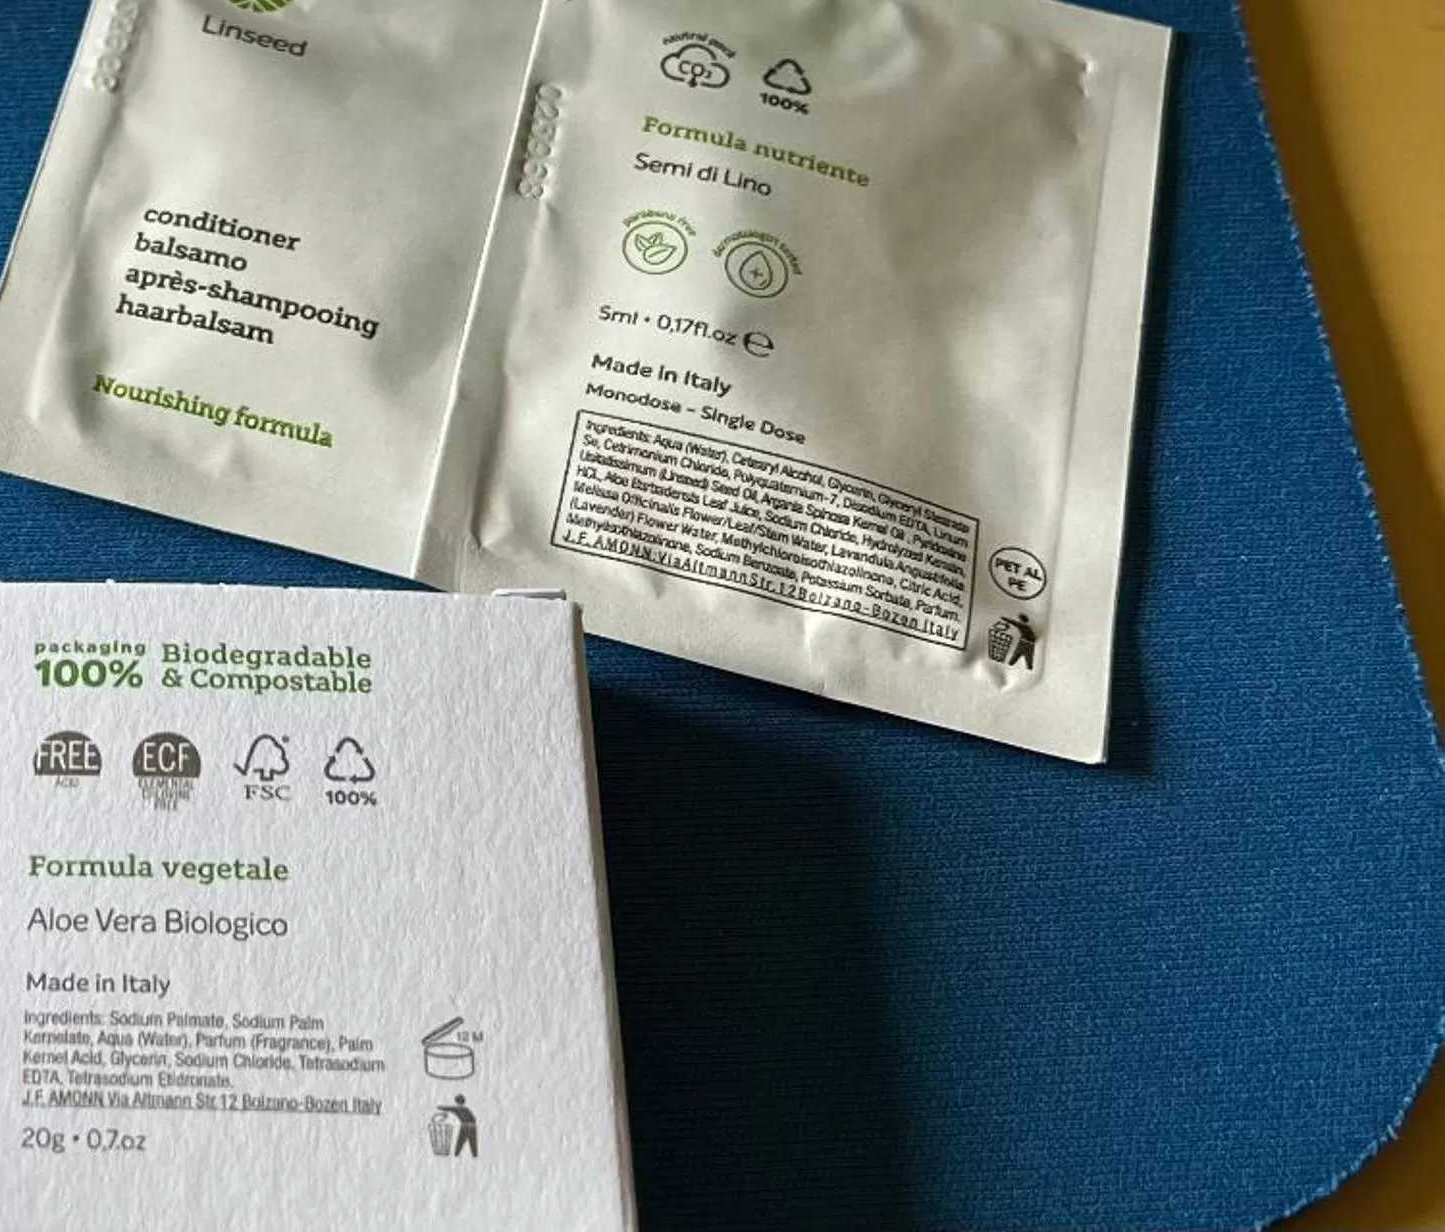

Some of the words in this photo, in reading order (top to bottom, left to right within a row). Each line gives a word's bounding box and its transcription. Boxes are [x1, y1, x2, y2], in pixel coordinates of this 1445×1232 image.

[202, 14, 308, 57] Linseed
[759, 92, 809, 115] 100%
[642, 116, 748, 152] Formula
[755, 141, 871, 188] nutriente
[633, 152, 693, 179] Semi
[697, 166, 718, 183] di
[724, 170, 772, 197] Lino
[144, 207, 301, 253] conditioner
[135, 233, 248, 273] balsamo
[125, 265, 380, 340] après-shampooing
[599, 305, 638, 326] 5ml
[116, 295, 275, 345] haarbalsam
[591, 354, 653, 377] Made
[658, 365, 678, 384] in
[684, 370, 732, 398] Italy
[93, 374, 231, 428] Nourishing
[233, 406, 335, 448] formula
[585, 382, 682, 414] Monodose
[700, 405, 756, 431] Single
[760, 420, 806, 445] Dose
[995, 557, 1022, 574] PET
[1008, 577, 1028, 592] PE
[34, 640, 146, 657] packaging
[162, 642, 372, 670] Biodegradable
[34, 659, 143, 689] 100%
[161, 670, 184, 688] &
[190, 669, 372, 695] Compostable
[36, 740, 99, 770] FREE
[143, 741, 191, 773] ECF
[244, 784, 291, 801] FSC
[325, 790, 377, 806] 100%
[28, 853, 152, 878] Formula
[161, 856, 289, 884] vegetale
[27, 907, 88, 932] Aloe
[95, 908, 157, 934] Vera
[164, 909, 288, 942] Biologico
[26, 972, 89, 993] Made
[95, 973, 115, 993] in
[122, 974, 171, 997] Italy
[109, 1010, 163, 1026] Sodium
[232, 1012, 285, 1029] Sodium
[290, 1014, 325, 1030] Palm
[96, 1030, 133, 1048] Aqua
[195, 1031, 246, 1048] Parfum
[339, 1035, 373, 1052] Palm
[22, 1050, 68, 1065] Kernel
[174, 1052, 228, 1068] Sodium
[299, 1054, 385, 1071] Tetrasodium
[67, 1069, 153, 1086] Tetrasodium
[21, 1126, 65, 1153] 20g
